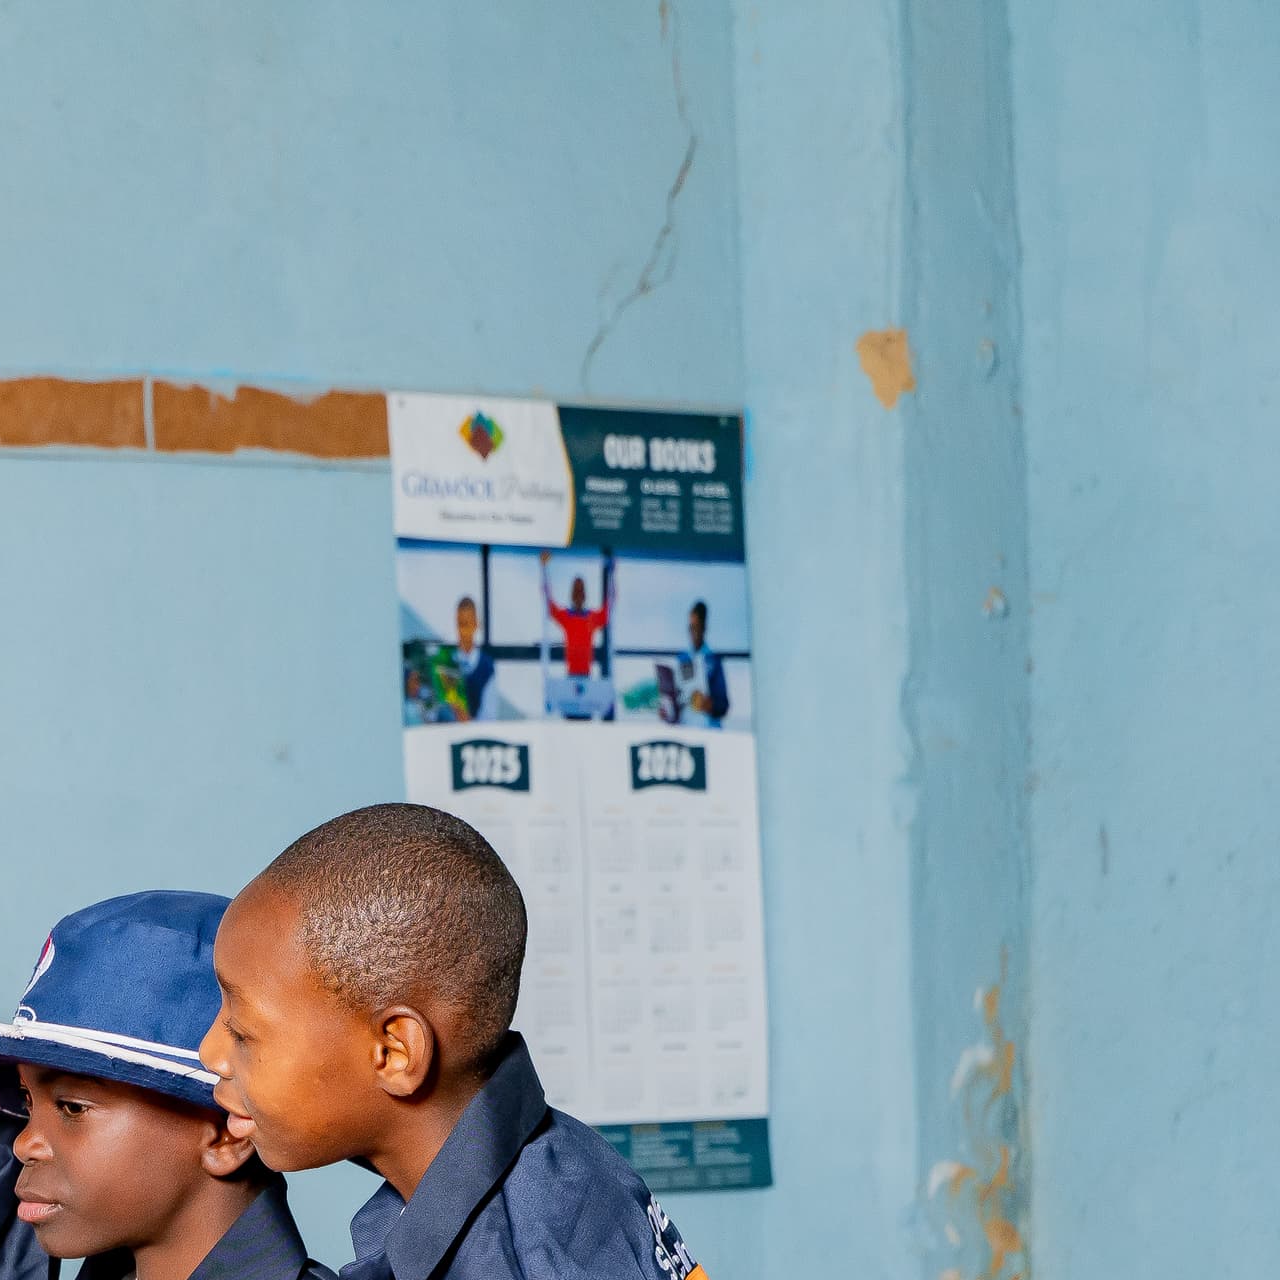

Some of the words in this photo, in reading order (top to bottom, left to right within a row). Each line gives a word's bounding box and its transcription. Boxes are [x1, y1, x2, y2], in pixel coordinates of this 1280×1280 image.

[604, 433, 646, 469] OUR
[649, 437, 716, 474] BOOKS
[459, 744, 523, 785] 2025
[637, 744, 696, 782] 2026
